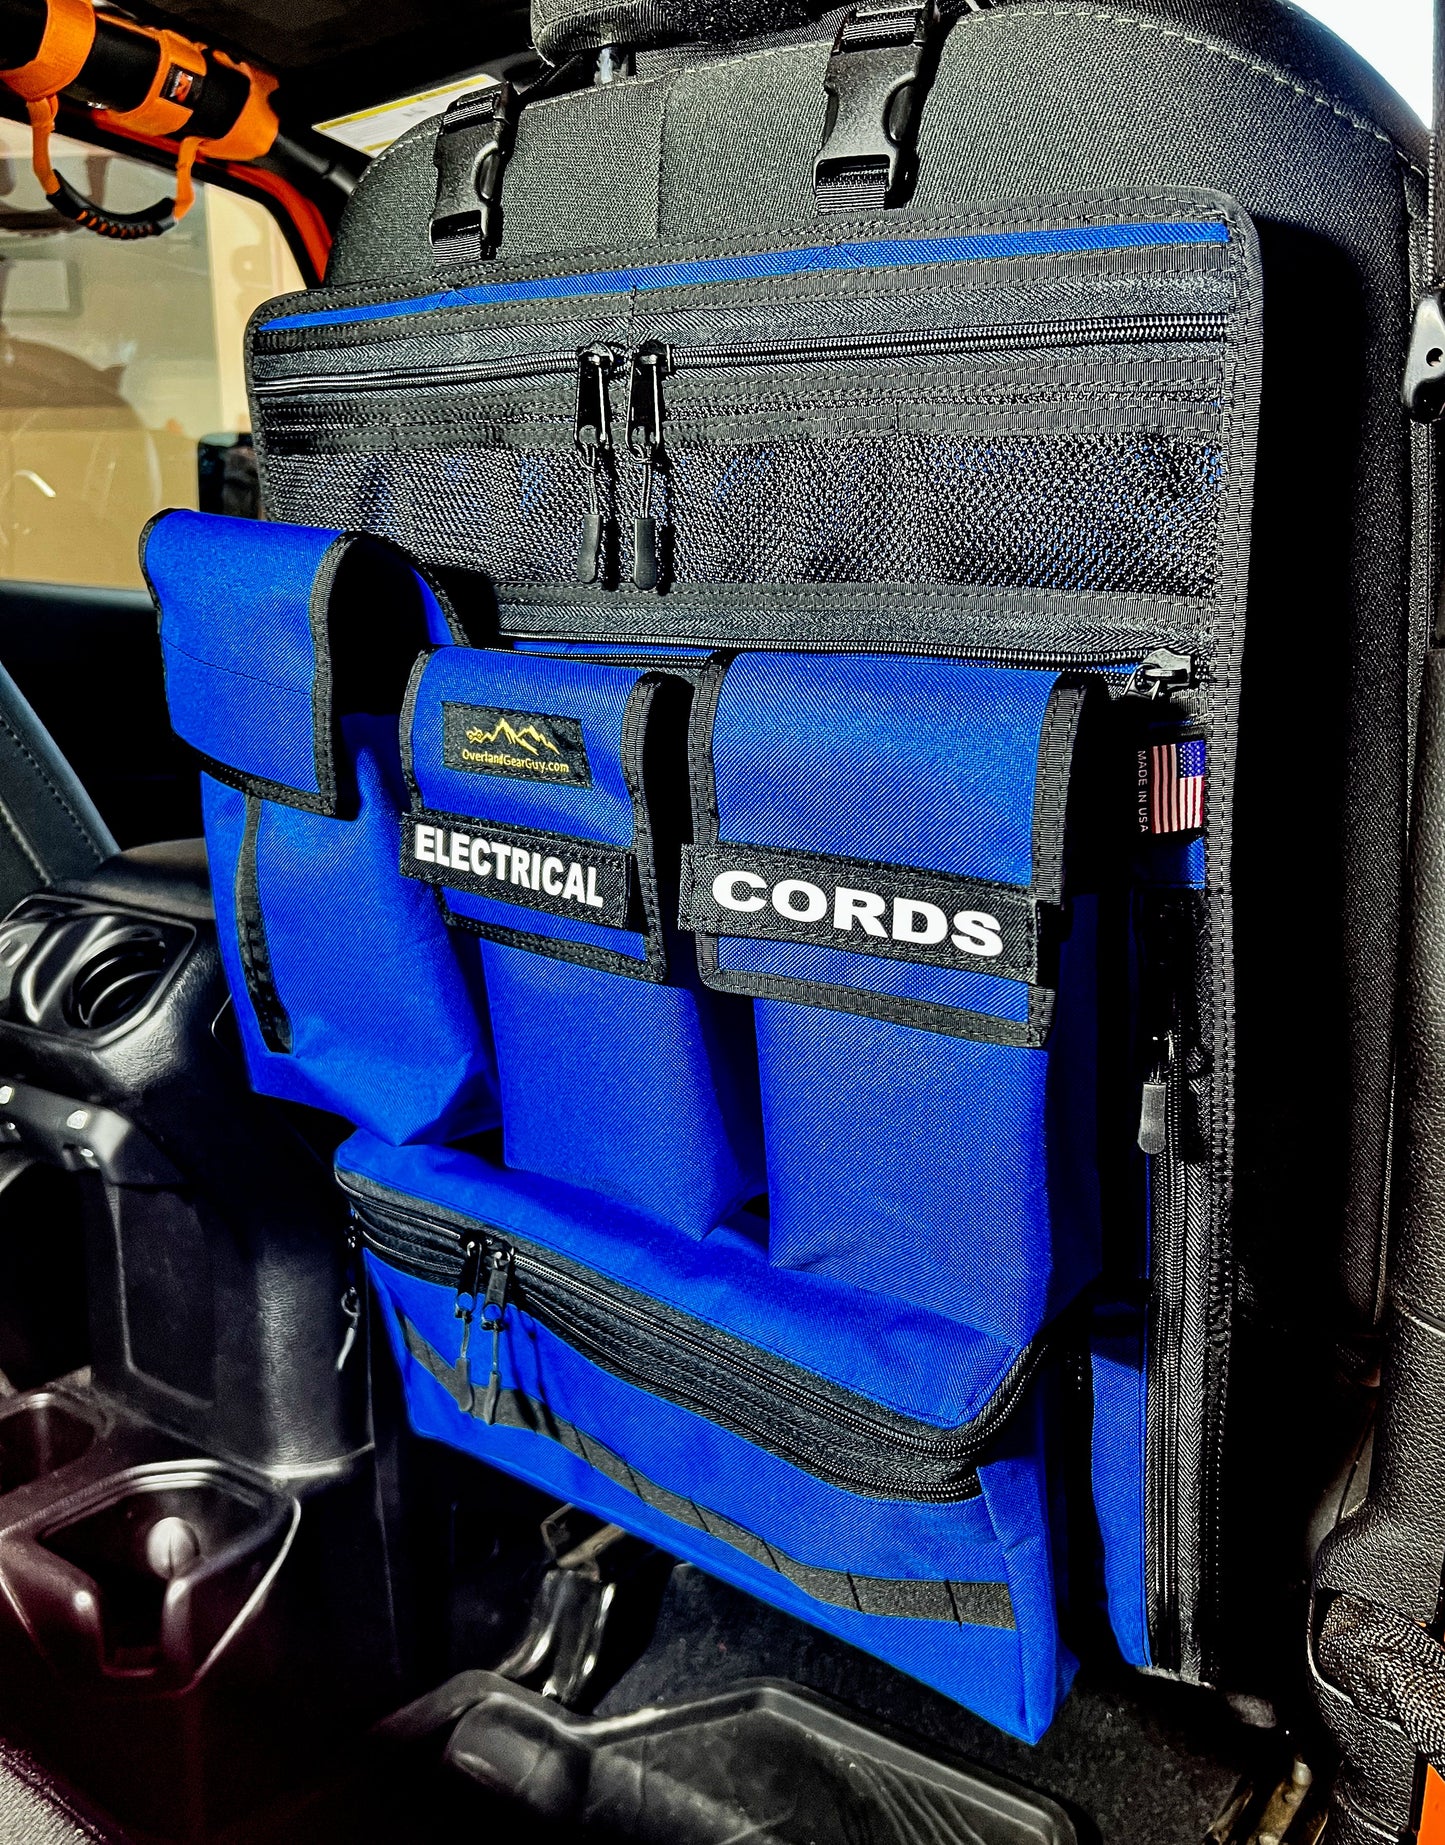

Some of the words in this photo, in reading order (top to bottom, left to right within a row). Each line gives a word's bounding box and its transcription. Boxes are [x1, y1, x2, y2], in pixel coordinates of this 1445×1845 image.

[462, 748, 569, 773] OverlandGearGuy.com
[1138, 750, 1148, 786] MADE
[1138, 791, 1148, 803] IN
[1139, 807, 1149, 833] USA
[415, 825, 604, 908] ELECTRICAL
[712, 870, 1004, 957] CORDS
